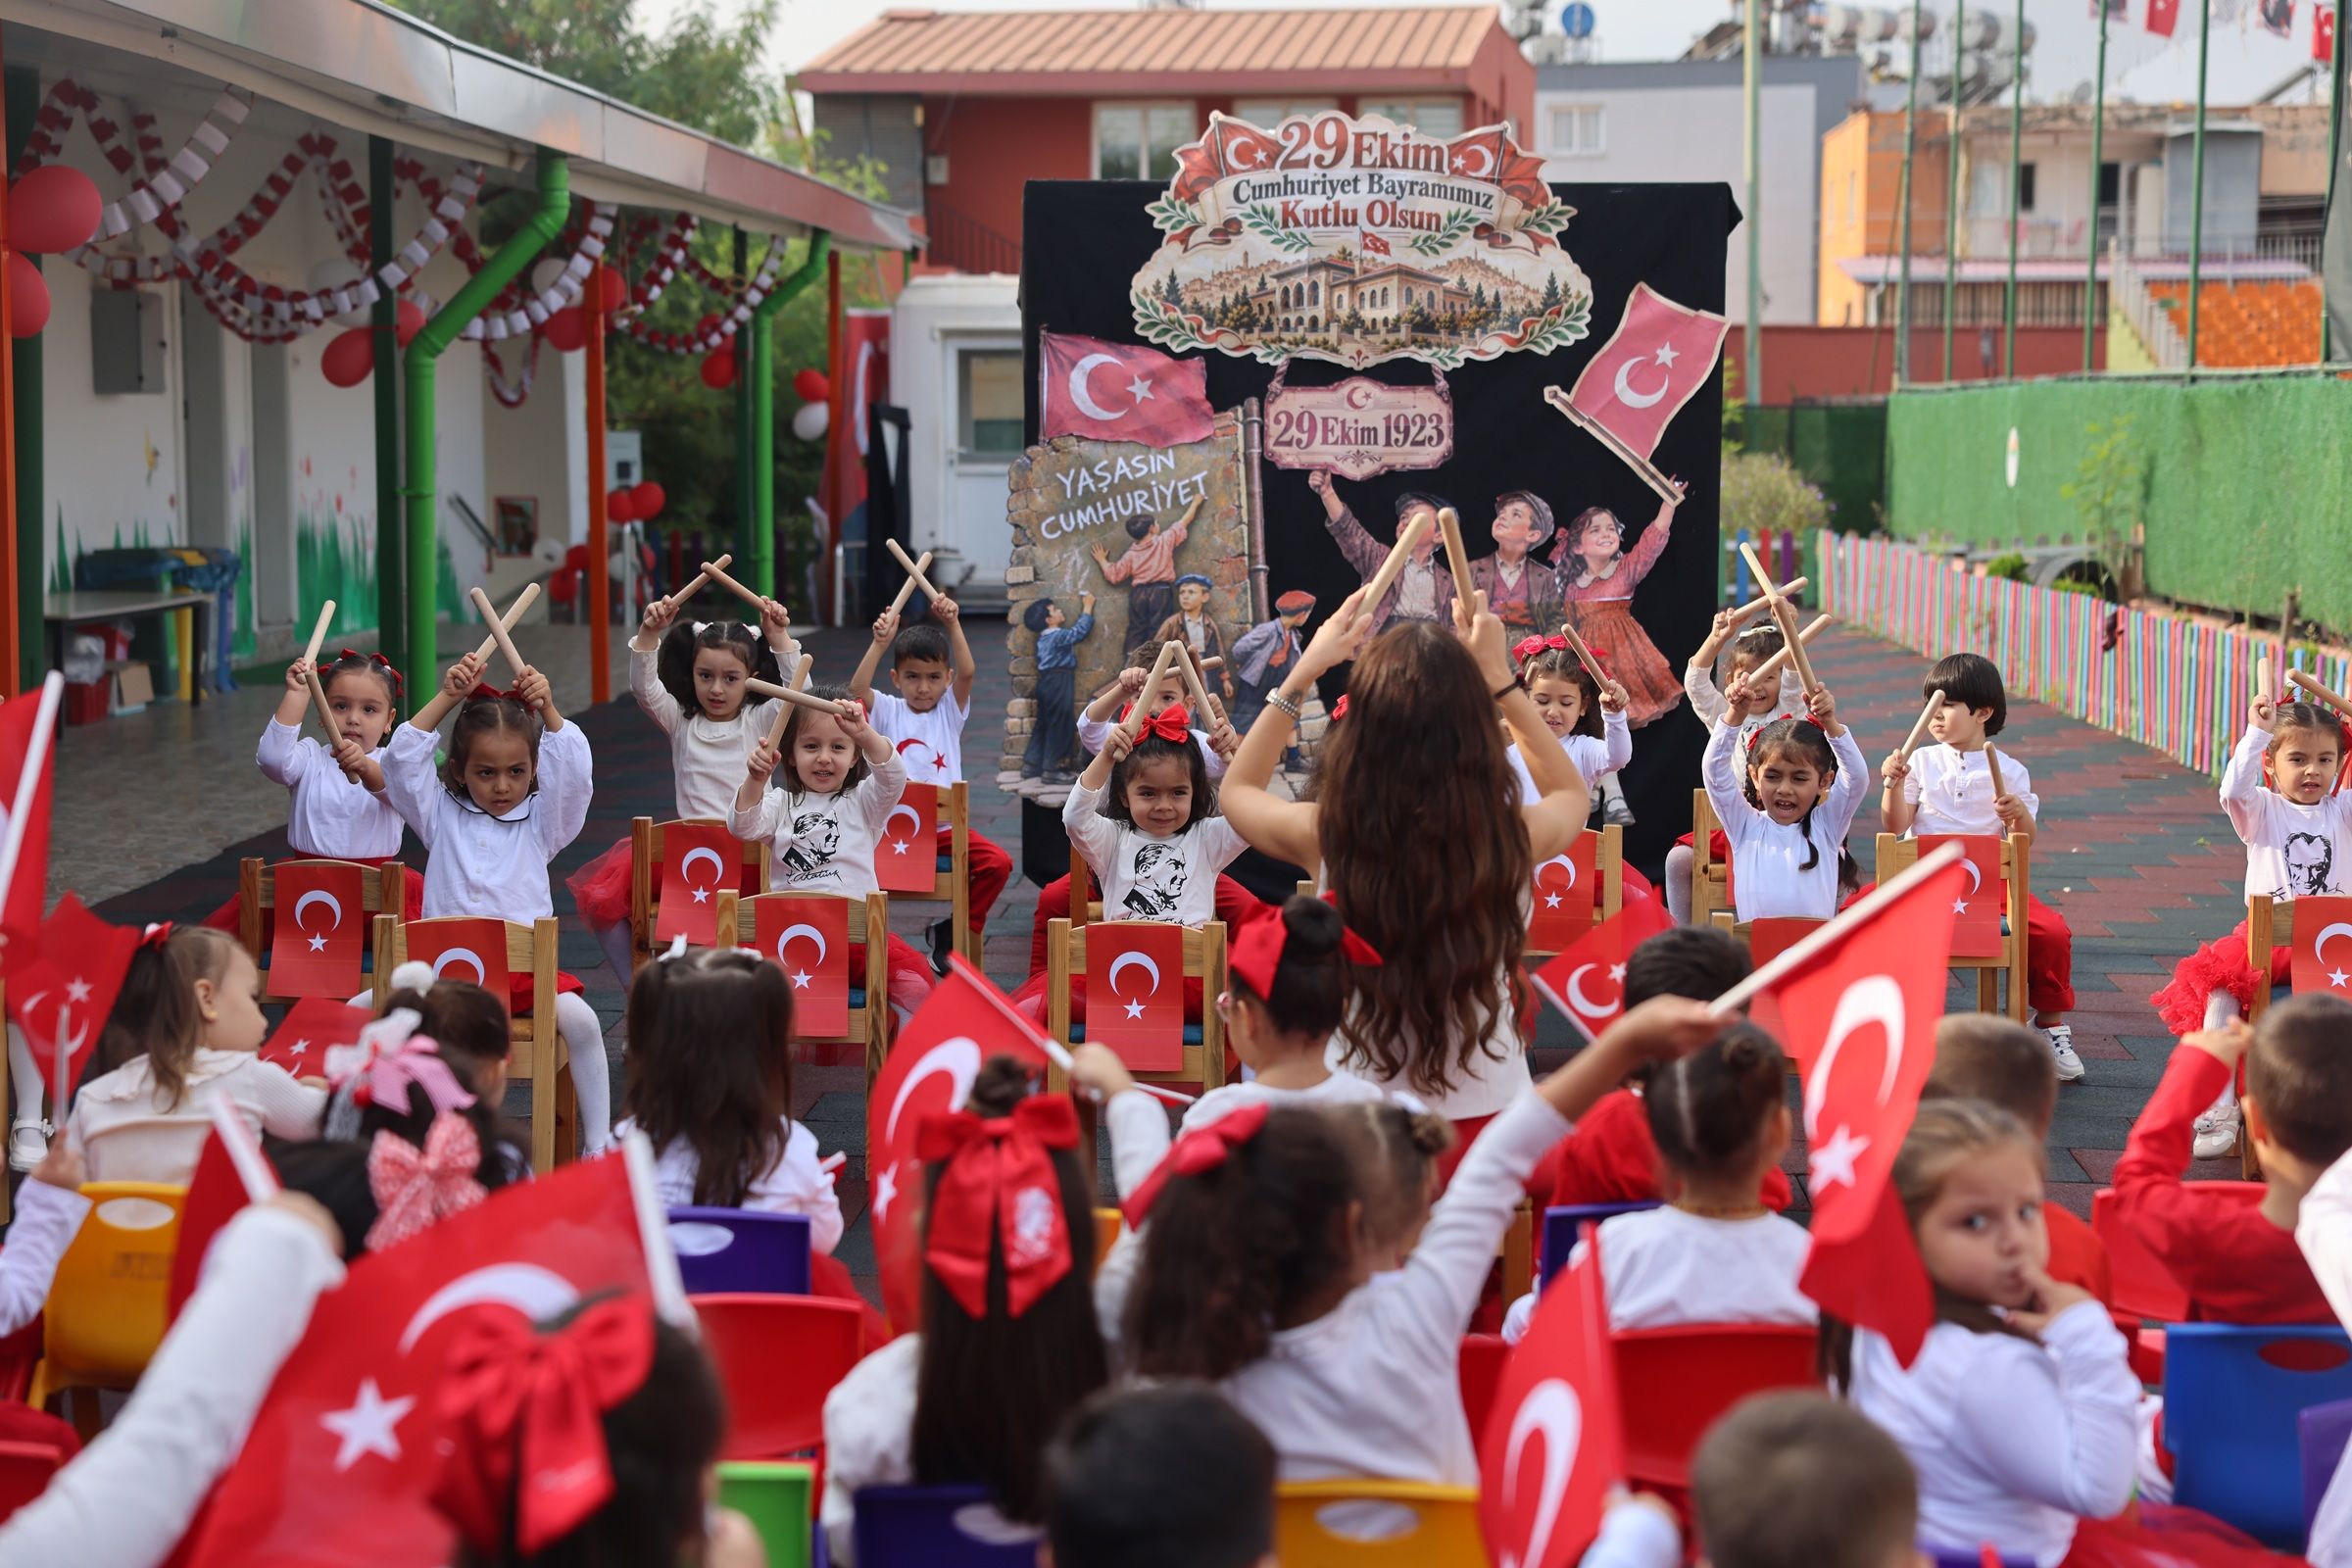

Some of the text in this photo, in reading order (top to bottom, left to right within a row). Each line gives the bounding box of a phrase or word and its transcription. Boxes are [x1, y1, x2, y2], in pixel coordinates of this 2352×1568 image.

[1280, 117, 1446, 174] 29 Ekim
[1233, 172, 1495, 210] Cumhuriyet Bayramımız
[1280, 199, 1443, 232] Kutlu Olsun
[1273, 410, 1446, 450] 29 Ekim 1923
[1055, 448, 1176, 499] YAŞASIN
[1040, 470, 1208, 539] CUMHURİYET
